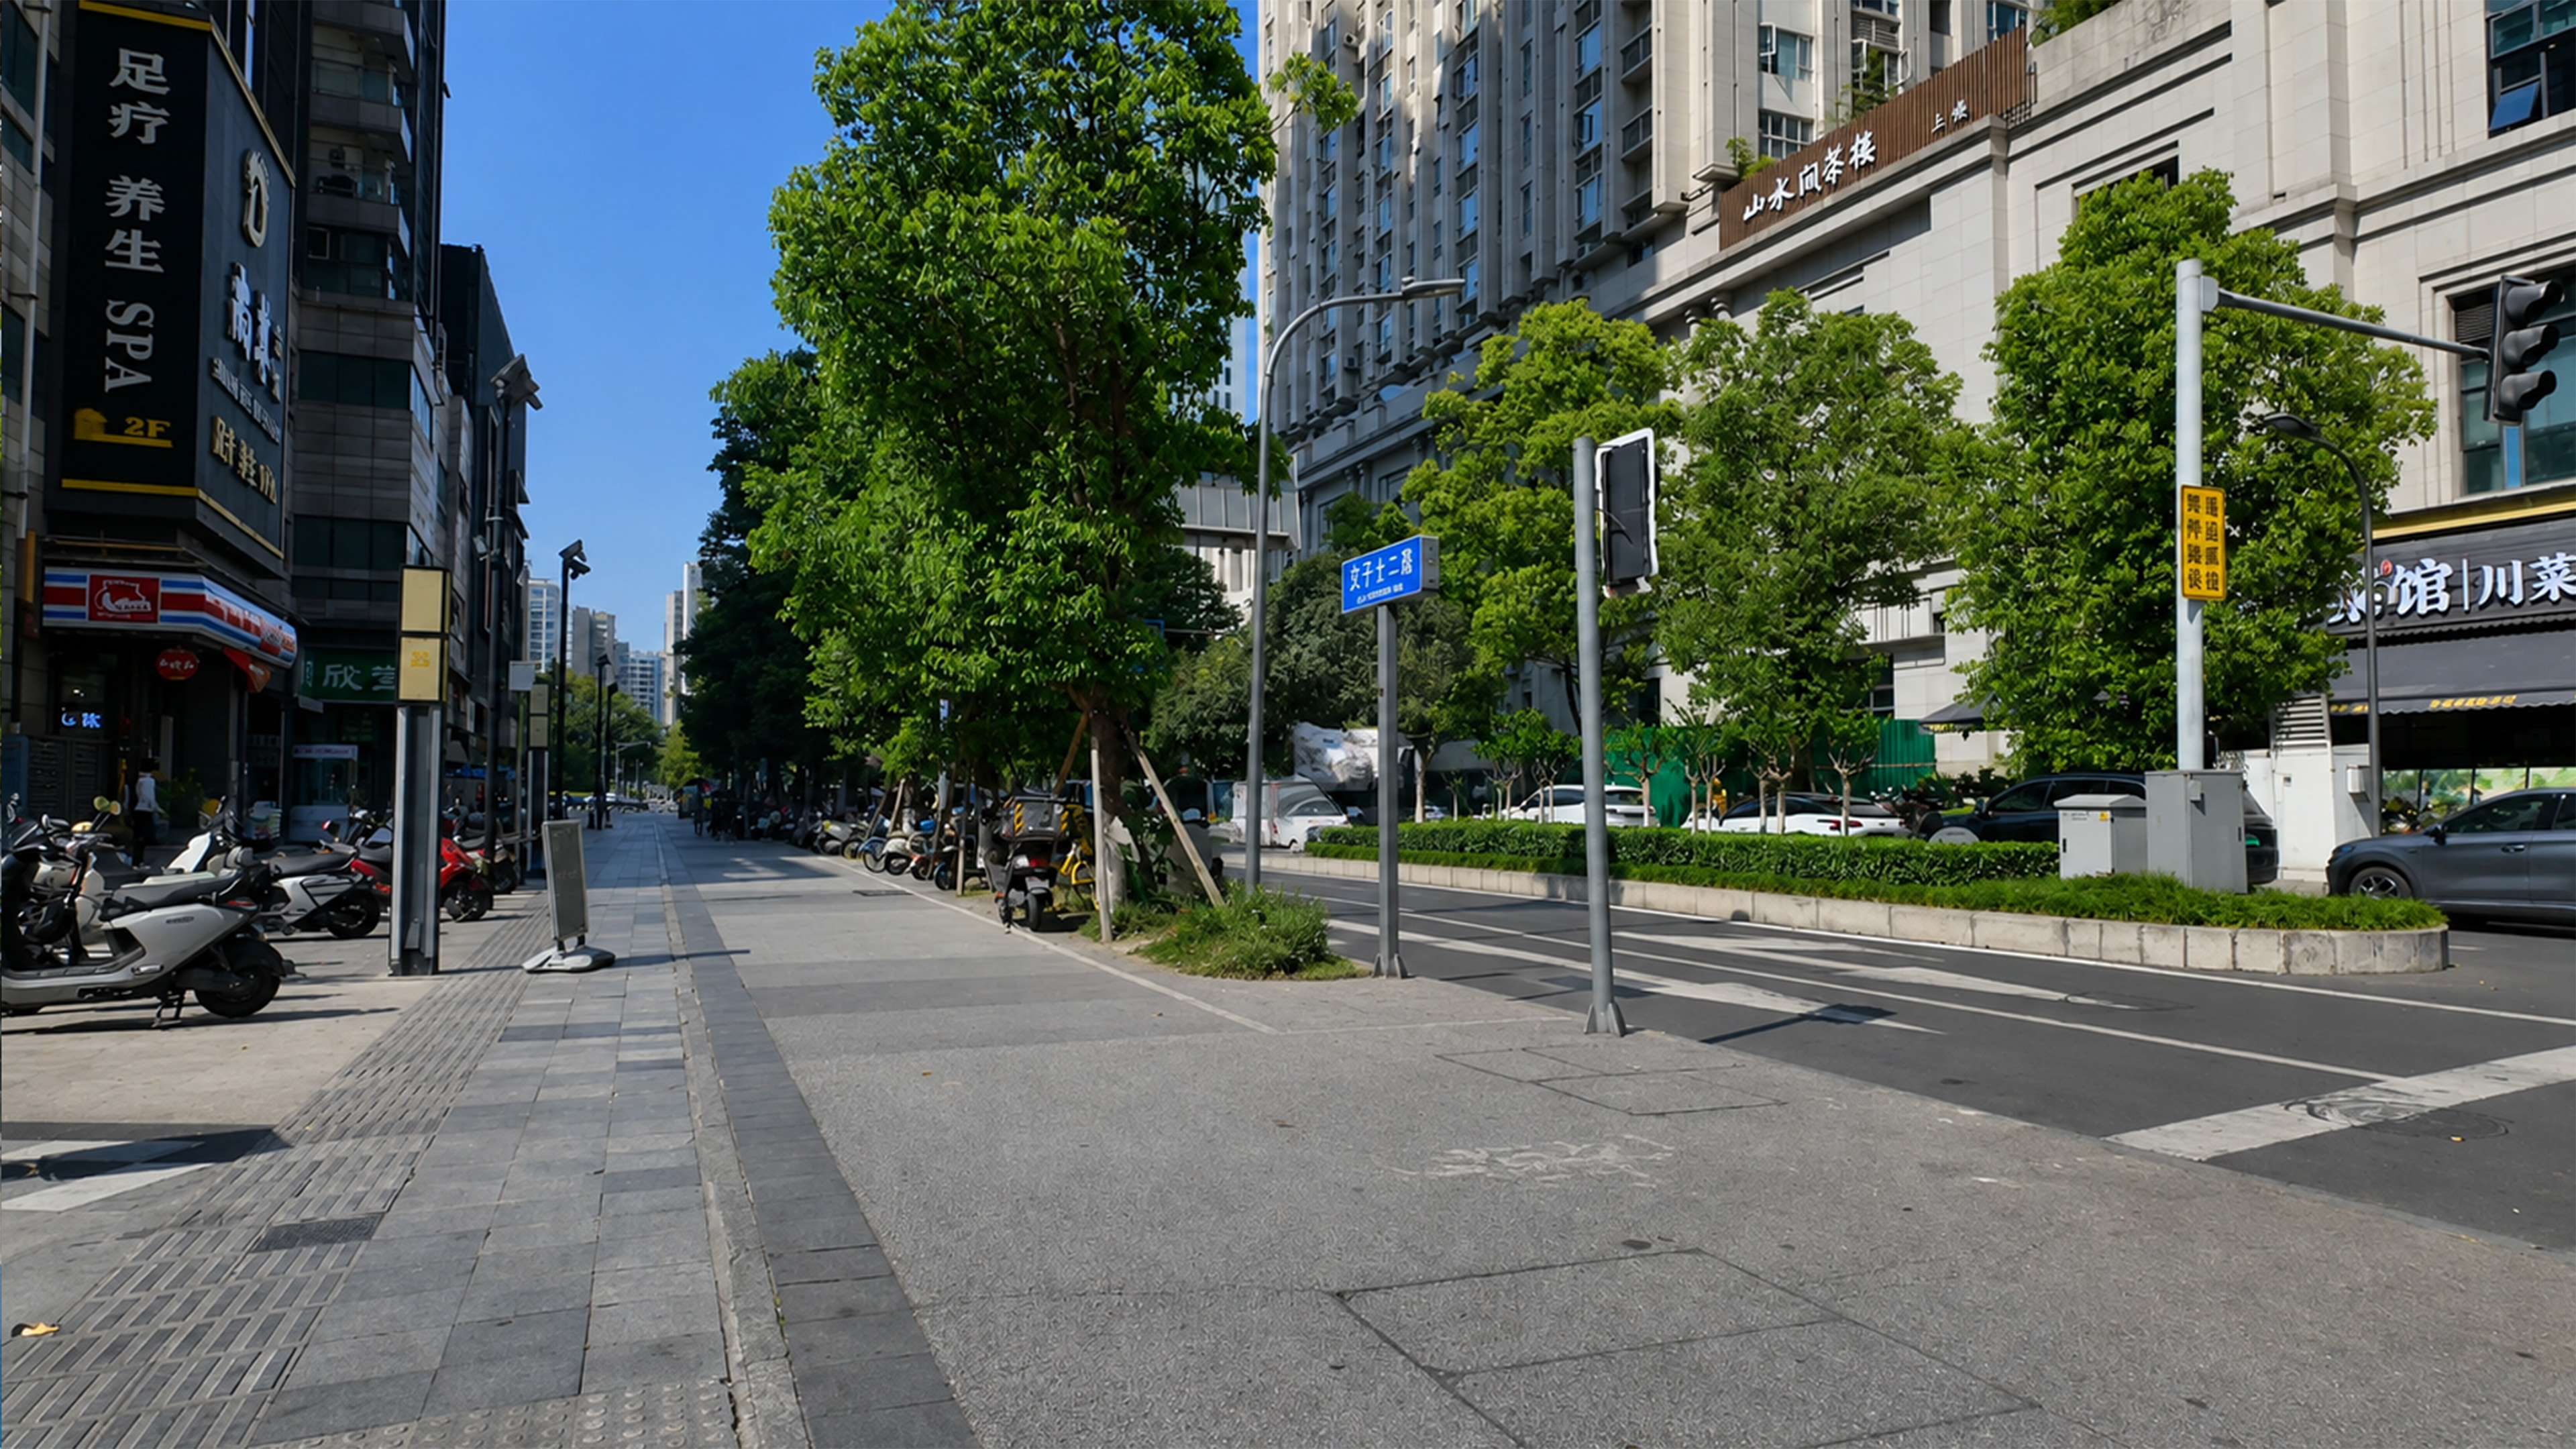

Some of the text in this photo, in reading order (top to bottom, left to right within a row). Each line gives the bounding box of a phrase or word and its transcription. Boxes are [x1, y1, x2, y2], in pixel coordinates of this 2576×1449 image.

[105, 47, 170, 393] 足疗 养生 SPA
[123, 416, 171, 437] 2F
[2477, 551, 2576, 606] 川菜
